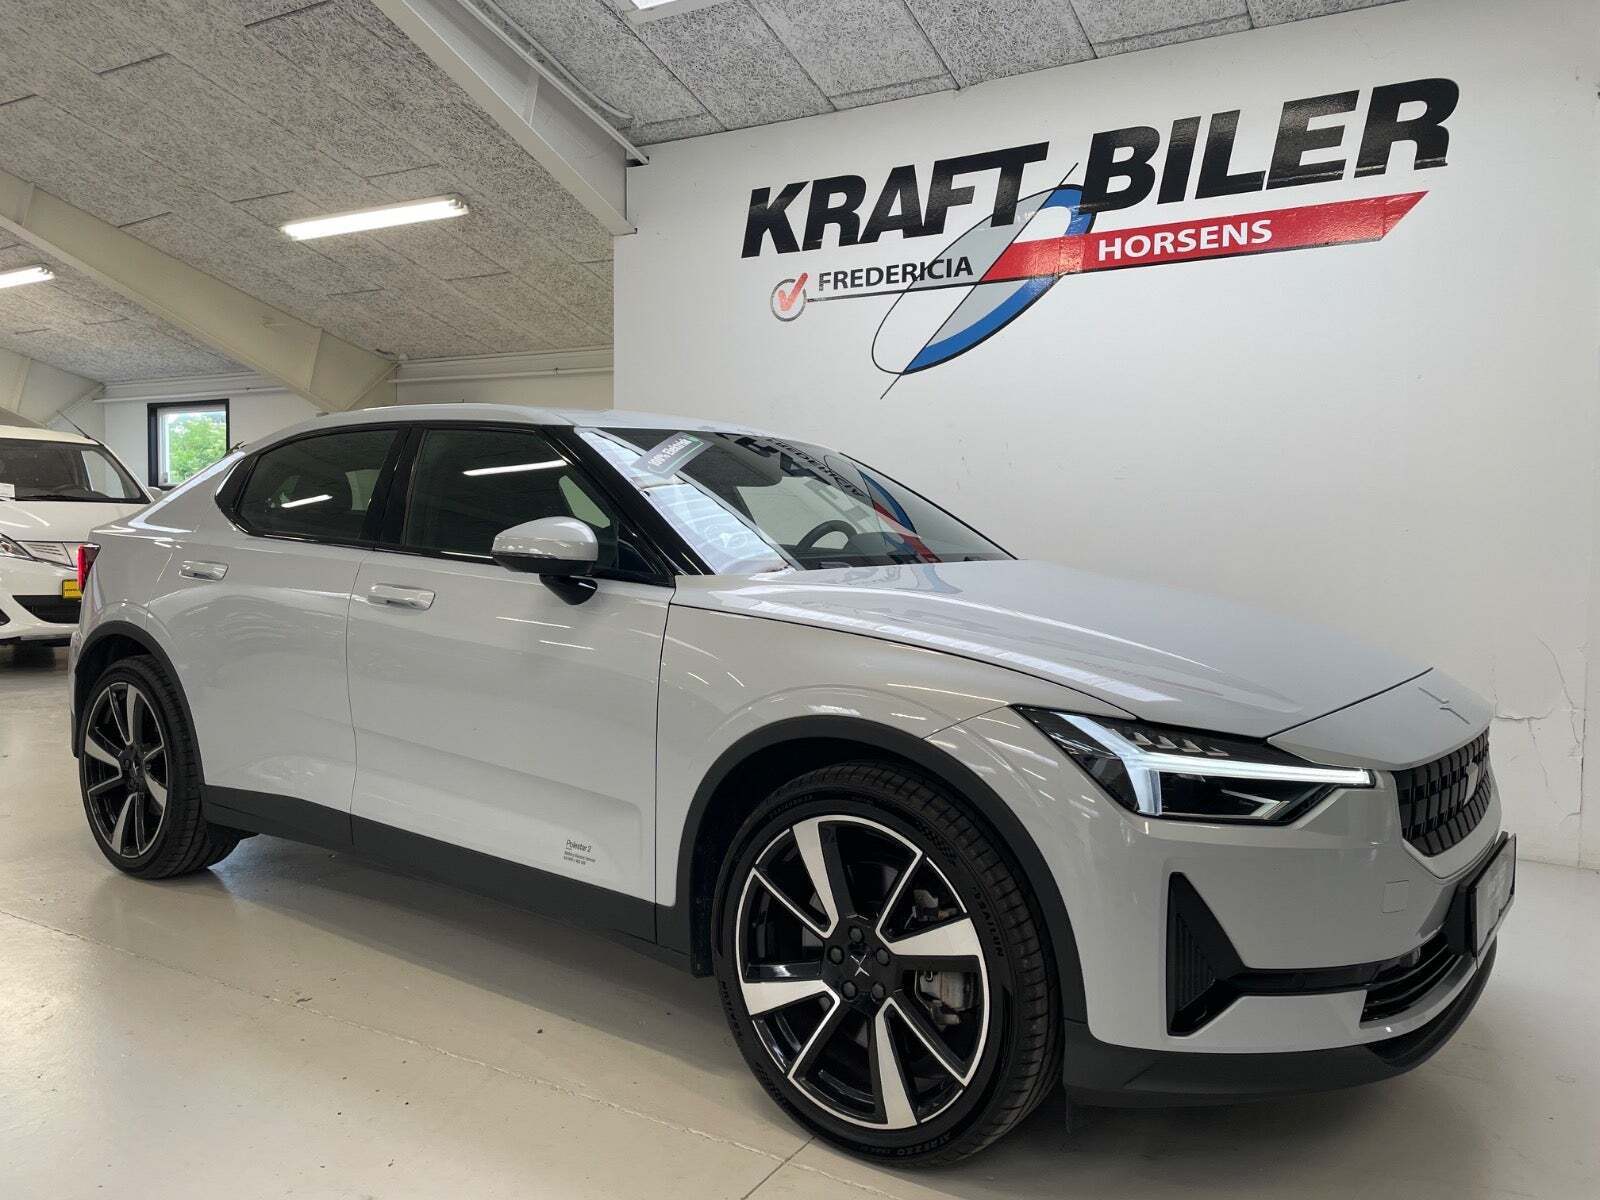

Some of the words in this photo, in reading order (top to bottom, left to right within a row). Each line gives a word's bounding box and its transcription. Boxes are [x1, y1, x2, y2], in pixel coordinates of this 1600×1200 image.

[741, 141, 1050, 259] KRAFT
[1079, 77, 1460, 215] BILER
[1098, 219, 1273, 262] HORSENS
[818, 256, 974, 291] FREDERICIA
